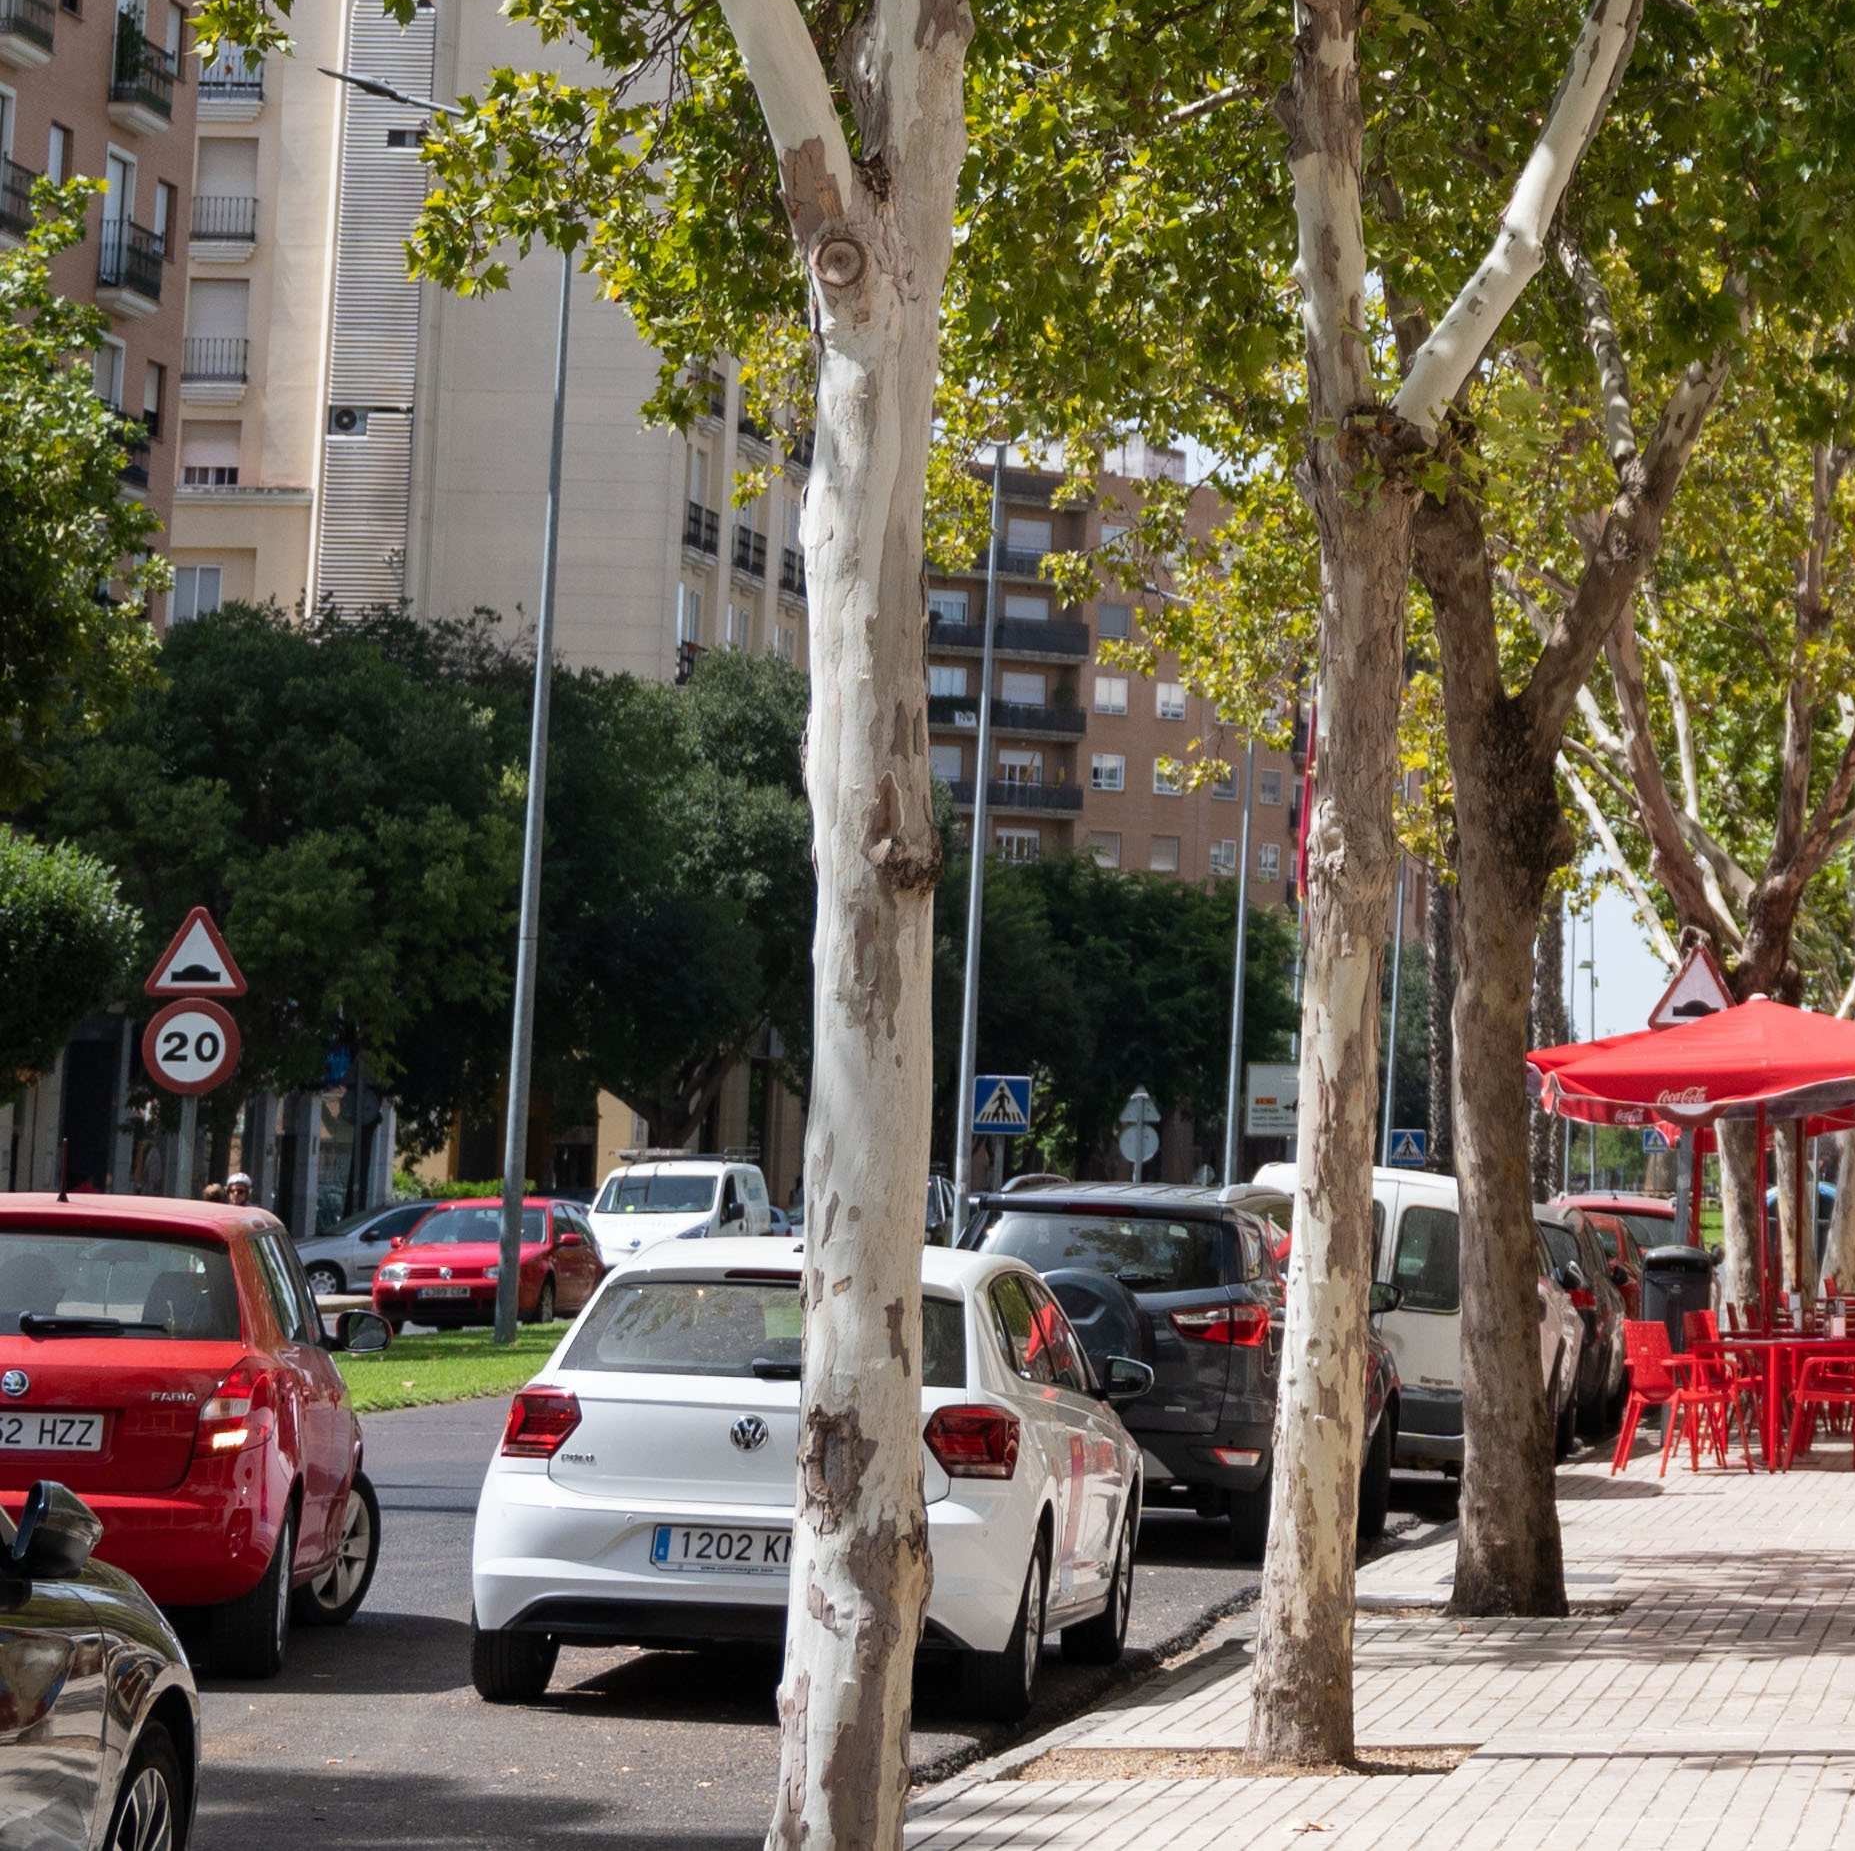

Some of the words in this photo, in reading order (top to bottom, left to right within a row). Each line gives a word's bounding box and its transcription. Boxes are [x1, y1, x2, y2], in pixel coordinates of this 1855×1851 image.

[161, 1031, 220, 1063] 20
[0, 1417, 23, 1445] 2
[38, 1419, 95, 1447] HZZ
[682, 1531, 753, 1562] 1202
